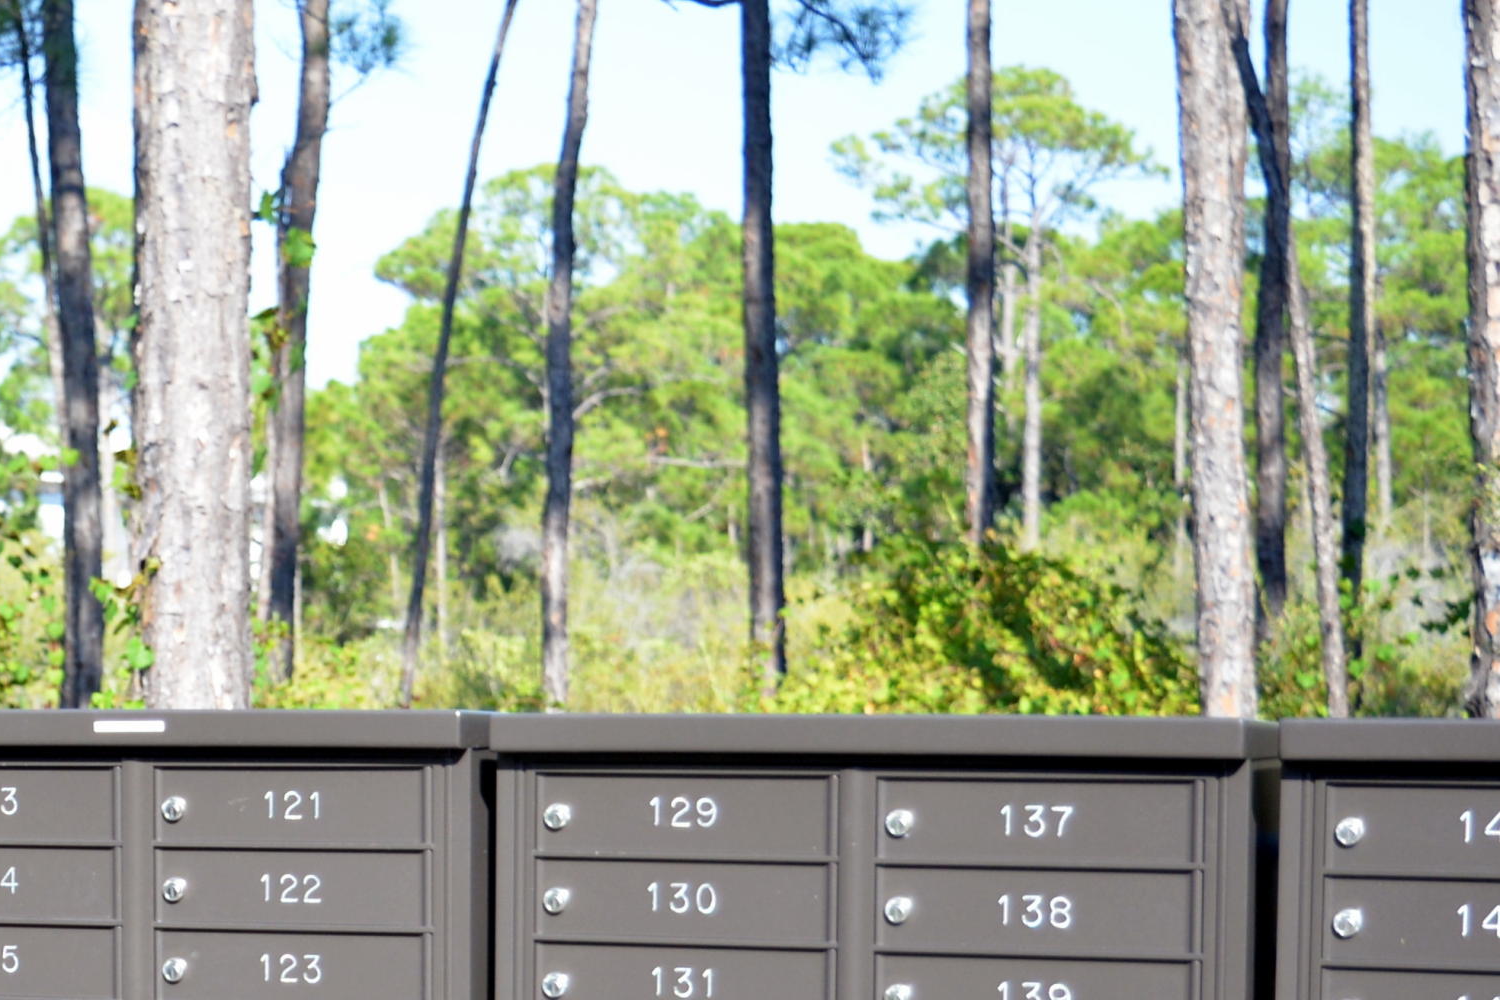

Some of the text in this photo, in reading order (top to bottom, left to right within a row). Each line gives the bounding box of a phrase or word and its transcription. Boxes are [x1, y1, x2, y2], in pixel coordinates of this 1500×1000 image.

[263, 789, 320, 821] 121
[649, 795, 719, 829] 129
[1000, 804, 1075, 839] 137
[259, 873, 322, 904] 122
[646, 881, 718, 915] 130
[997, 894, 1073, 930] 138
[259, 953, 322, 985] 123
[651, 966, 714, 999] 131
